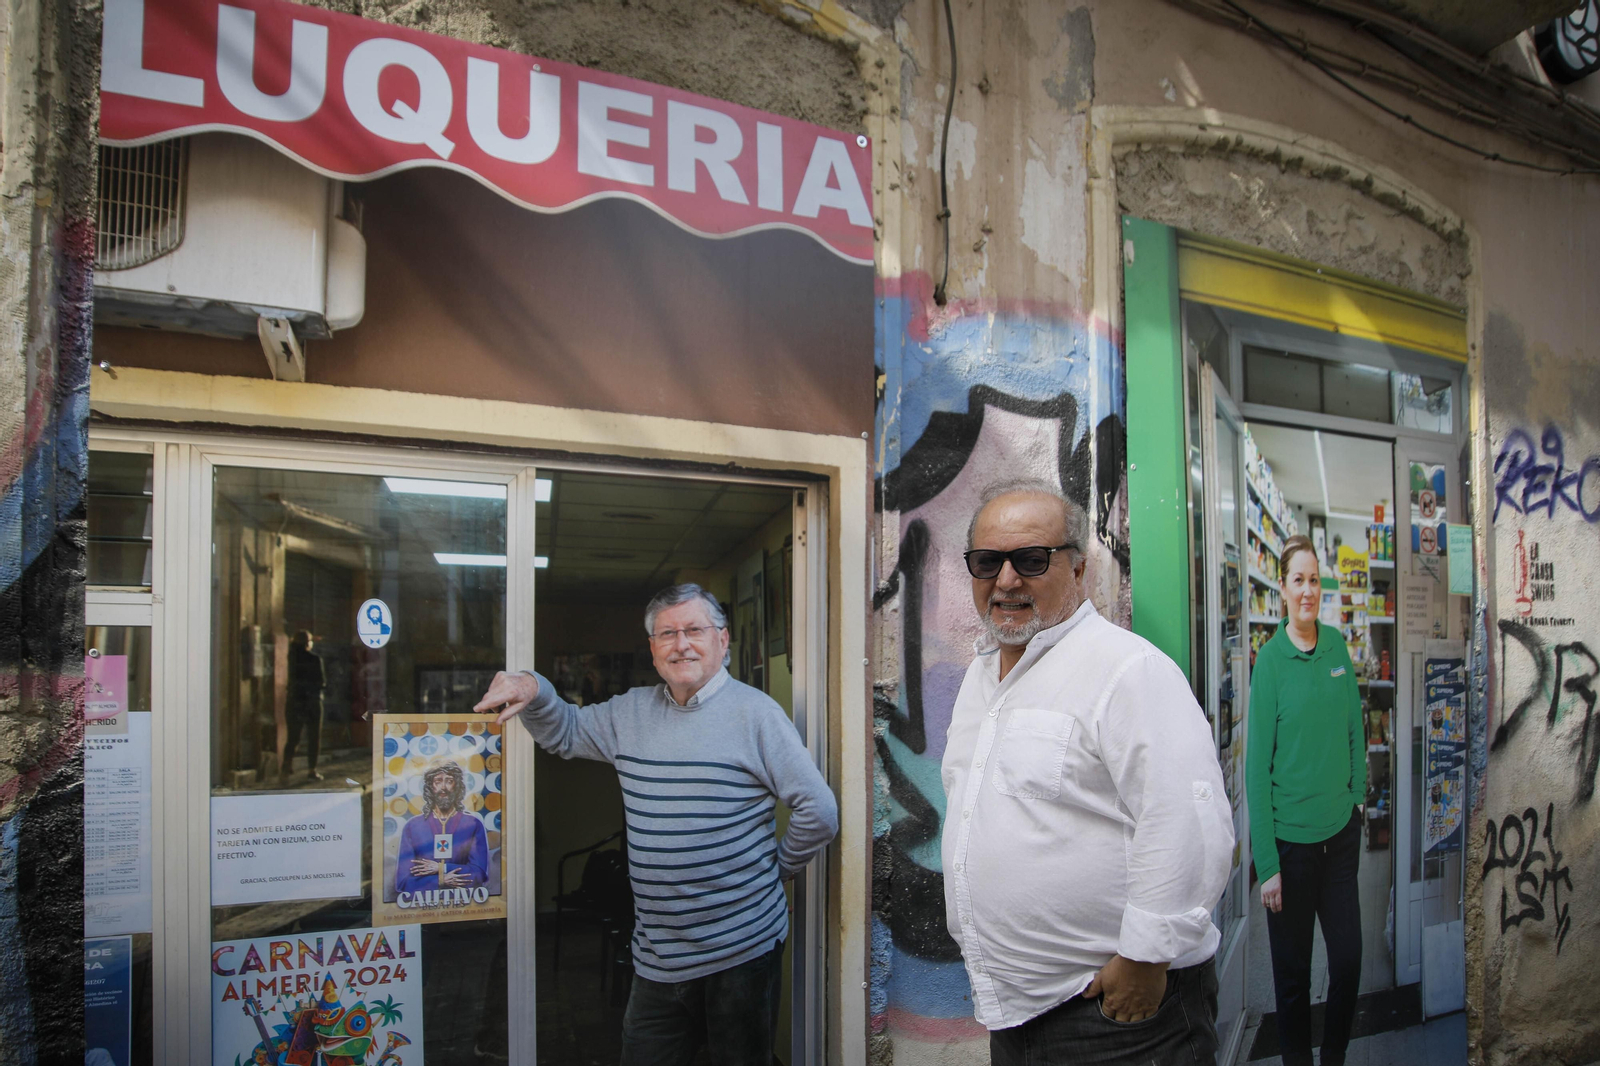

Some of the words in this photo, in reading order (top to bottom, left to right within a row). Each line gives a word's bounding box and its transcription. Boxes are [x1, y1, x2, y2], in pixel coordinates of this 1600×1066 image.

[101, 0, 874, 227] LUQUERIA
[1530, 562, 1554, 581] CAUSA
[1433, 663, 1451, 671] SUPREMO
[231, 827, 240, 835] SE
[242, 826, 273, 834] ADMITE
[309, 823, 326, 831] CON
[263, 837, 280, 845] CON
[281, 836, 309, 844] BIZUM,
[311, 834, 331, 842] SOLO
[217, 851, 256, 860] EFECTIVO.
[269, 874, 300, 882] DISCULPEN
[397, 886, 489, 909] CAUTIVO
[88, 948, 112, 957] DE
[211, 930, 416, 977] CARNAVAL
[344, 963, 407, 988] 2024
